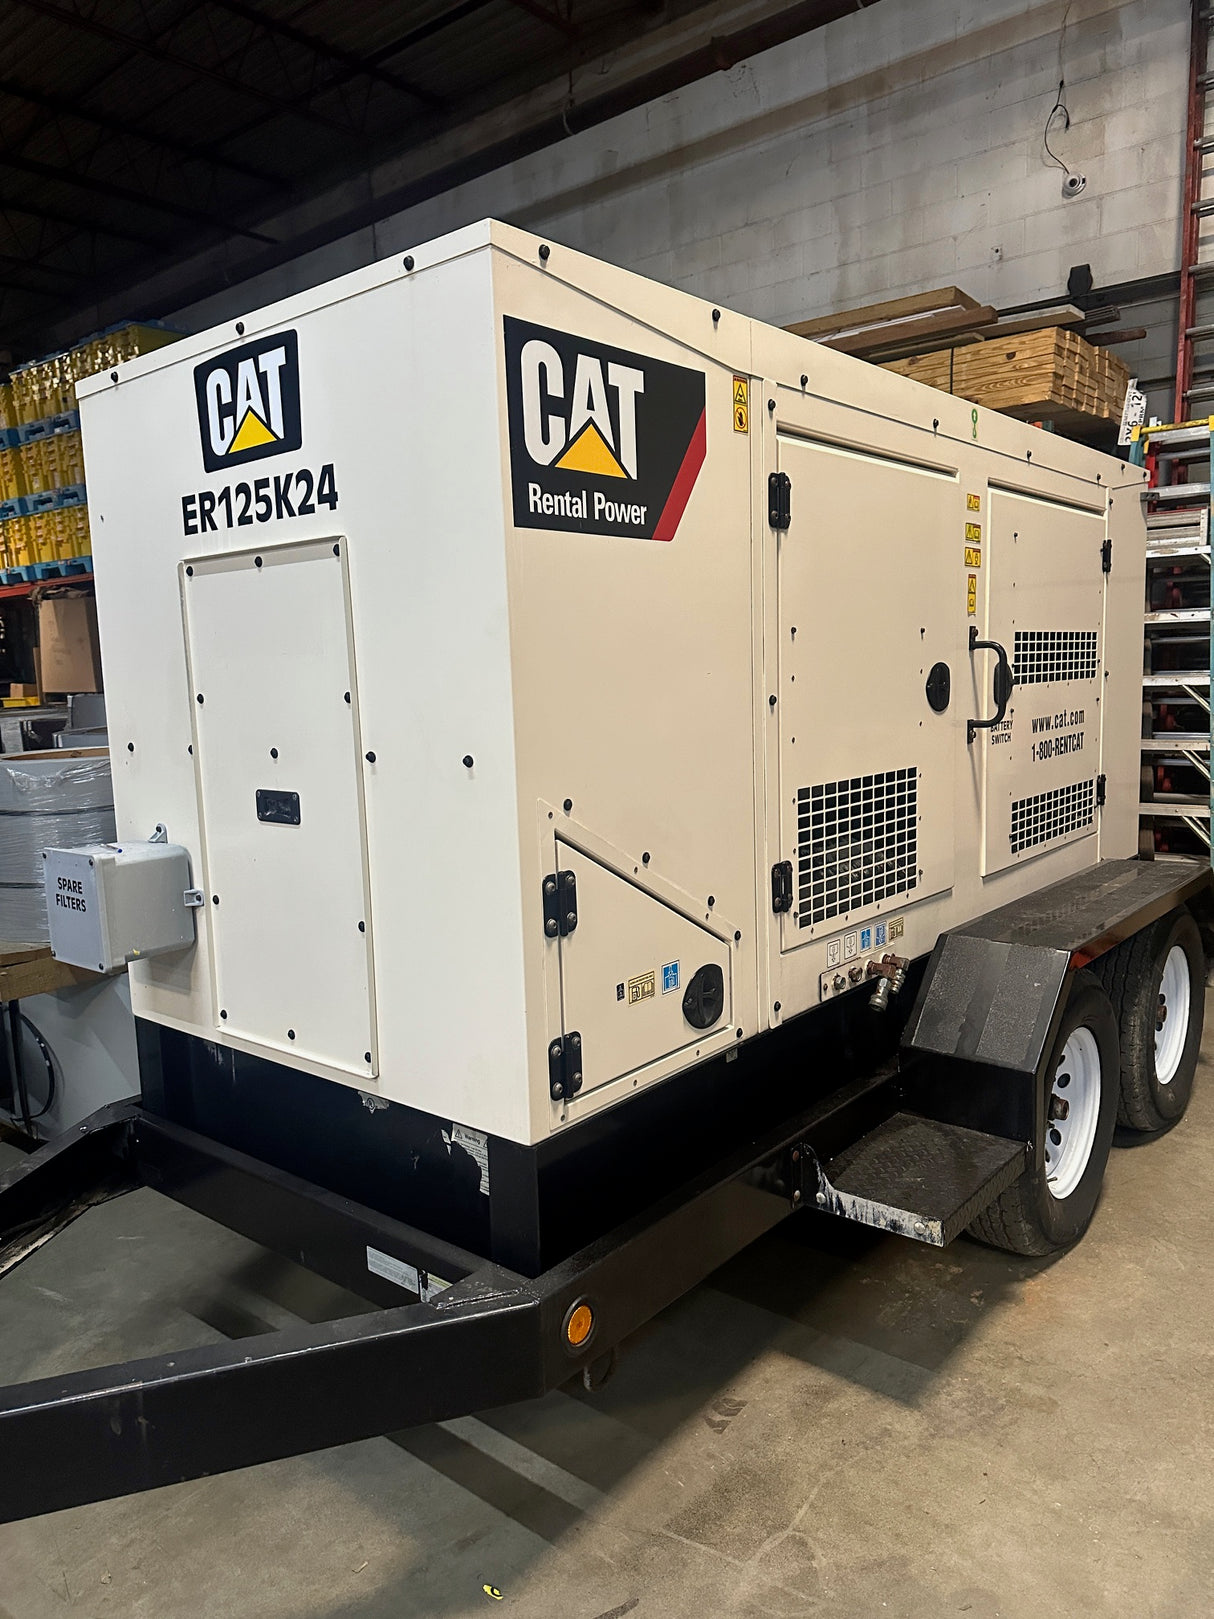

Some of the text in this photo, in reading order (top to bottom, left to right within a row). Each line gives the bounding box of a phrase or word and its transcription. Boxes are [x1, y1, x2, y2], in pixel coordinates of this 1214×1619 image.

[206, 346, 286, 456] CAT
[520, 339, 645, 480] CAT
[181, 463, 339, 536] ER125K24
[528, 482, 647, 525] Rental Power
[1031, 709, 1085, 733] www.cat.com
[991, 732, 1012, 745] SWITCH
[1031, 732, 1085, 762] 1-800-RENTCAT
[57, 876, 83, 895] SPARE
[55, 893, 87, 912] FILTERS
